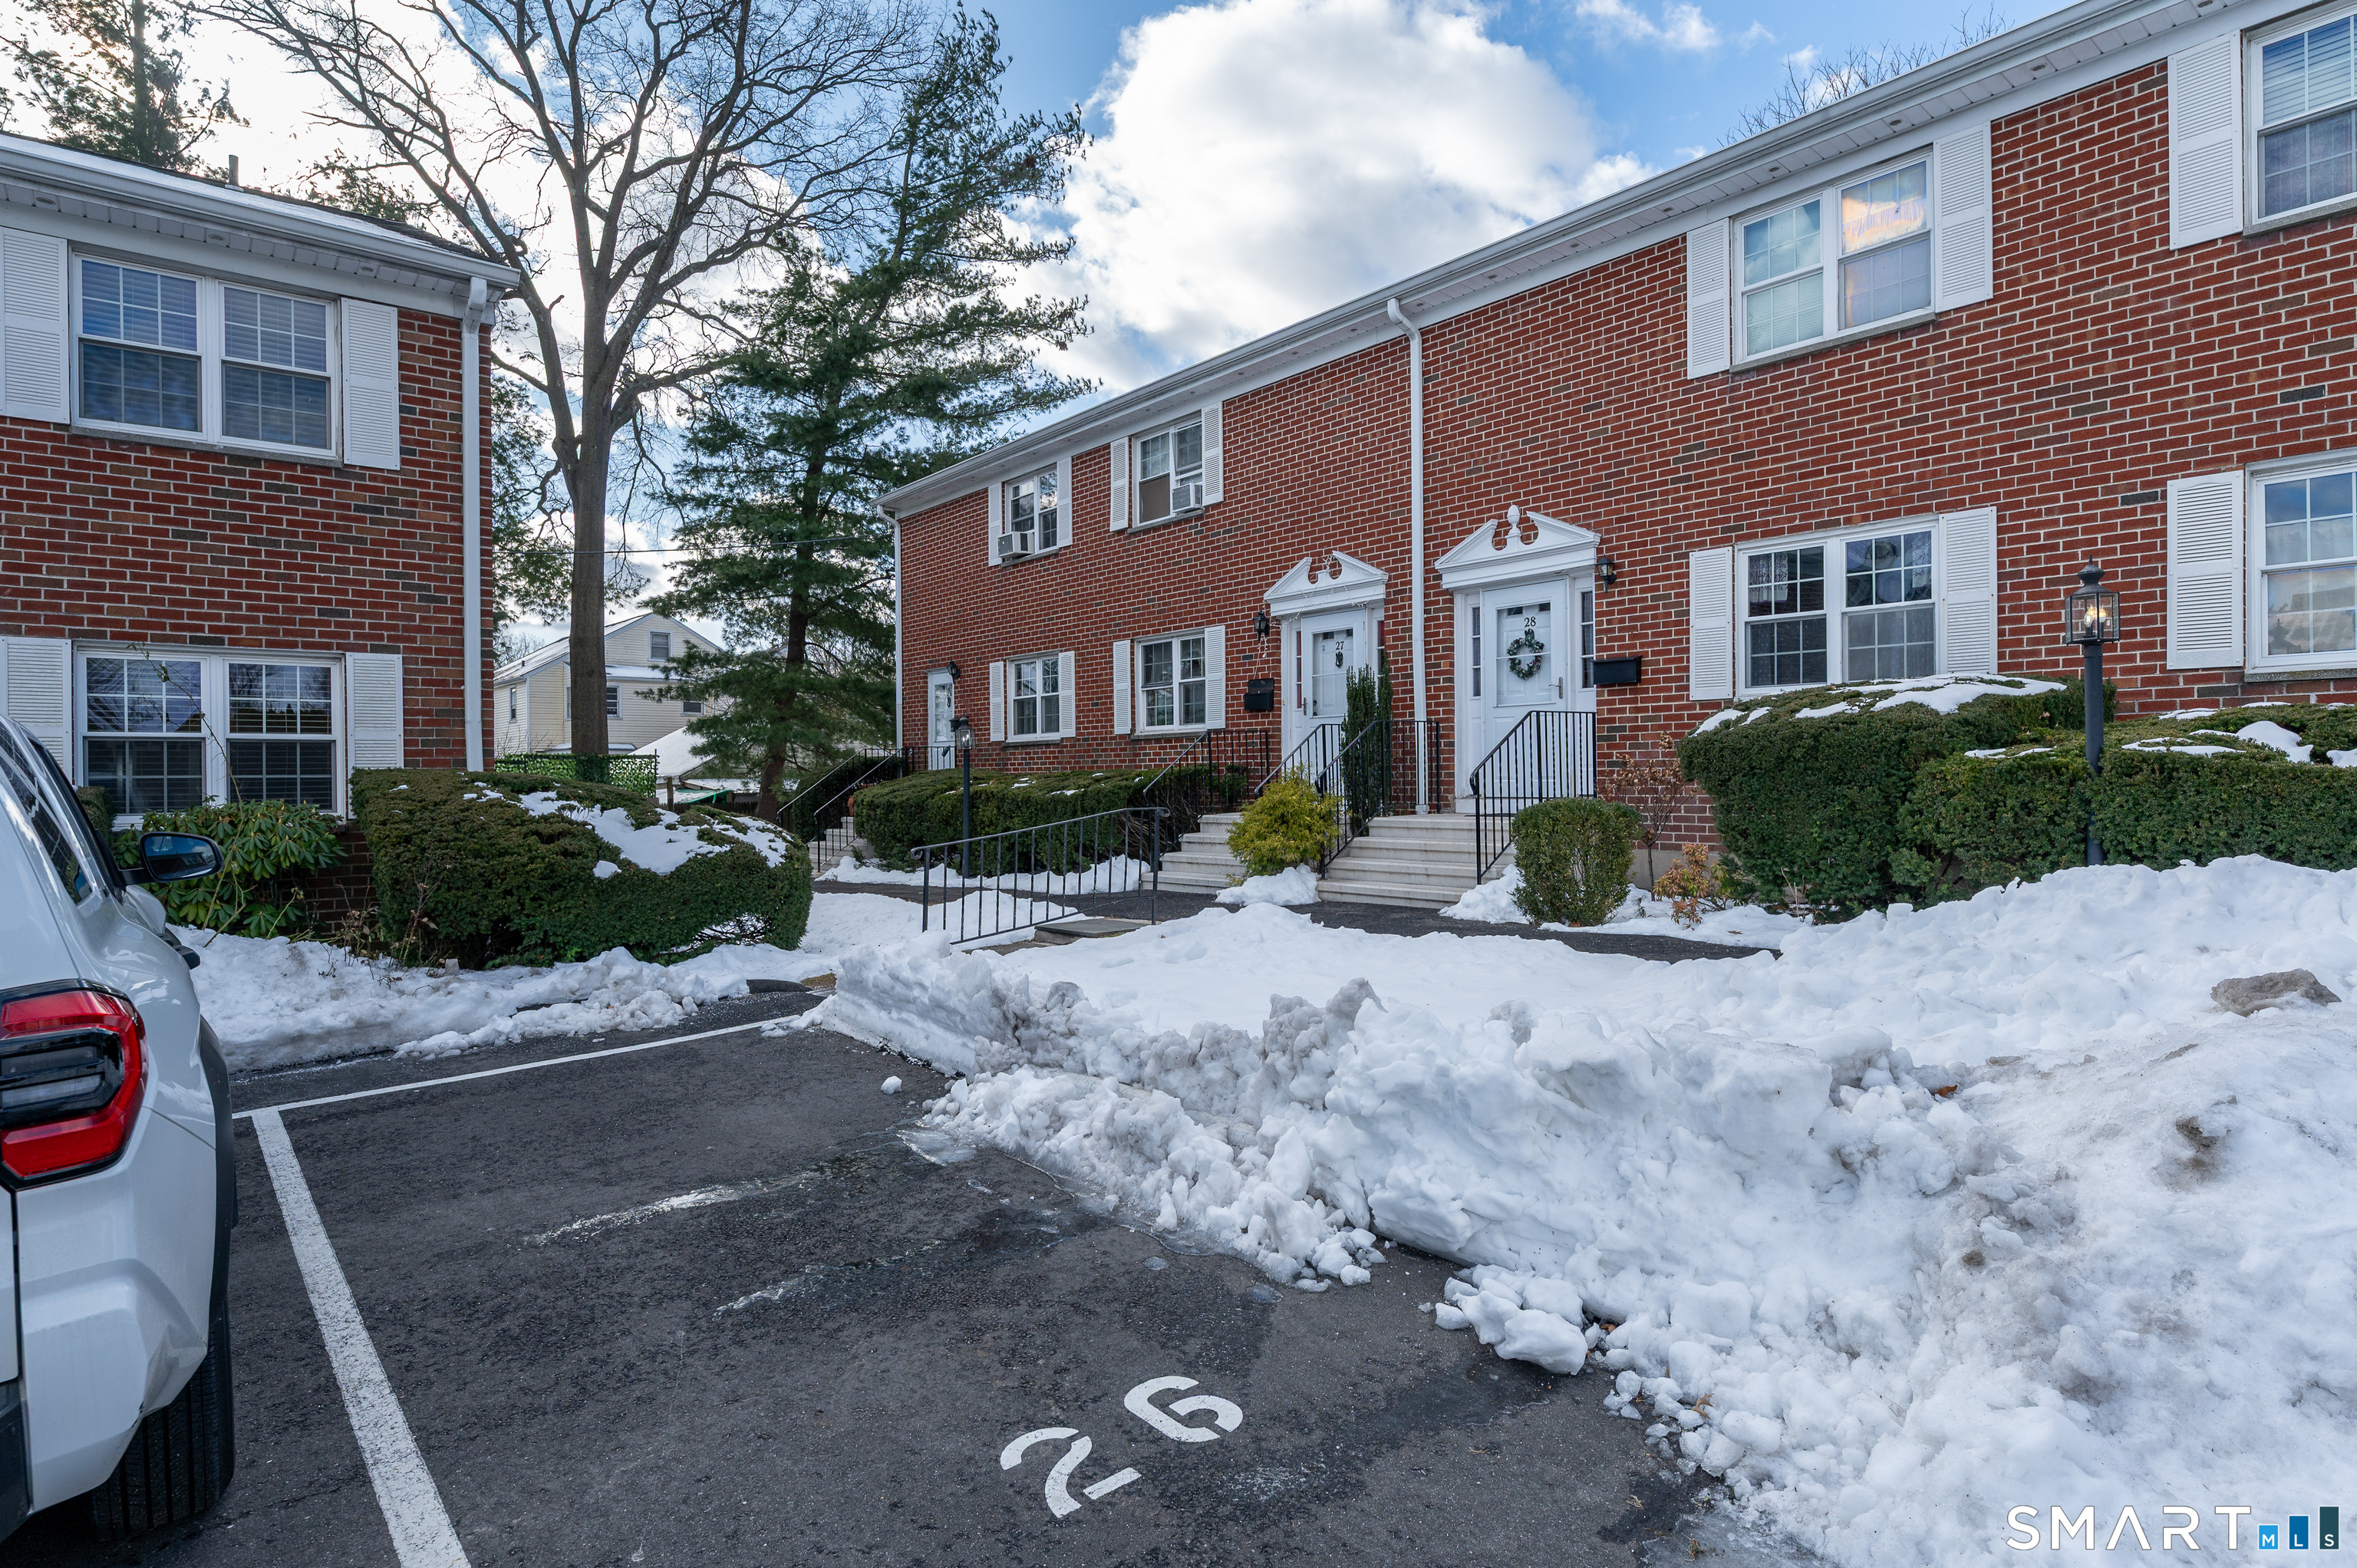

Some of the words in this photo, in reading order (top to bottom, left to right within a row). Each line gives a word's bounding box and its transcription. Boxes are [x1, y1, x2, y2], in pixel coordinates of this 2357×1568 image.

[1524, 616, 1536, 628] 28
[1335, 641, 1344, 651] 27
[1000, 1375, 1243, 1518] 26
